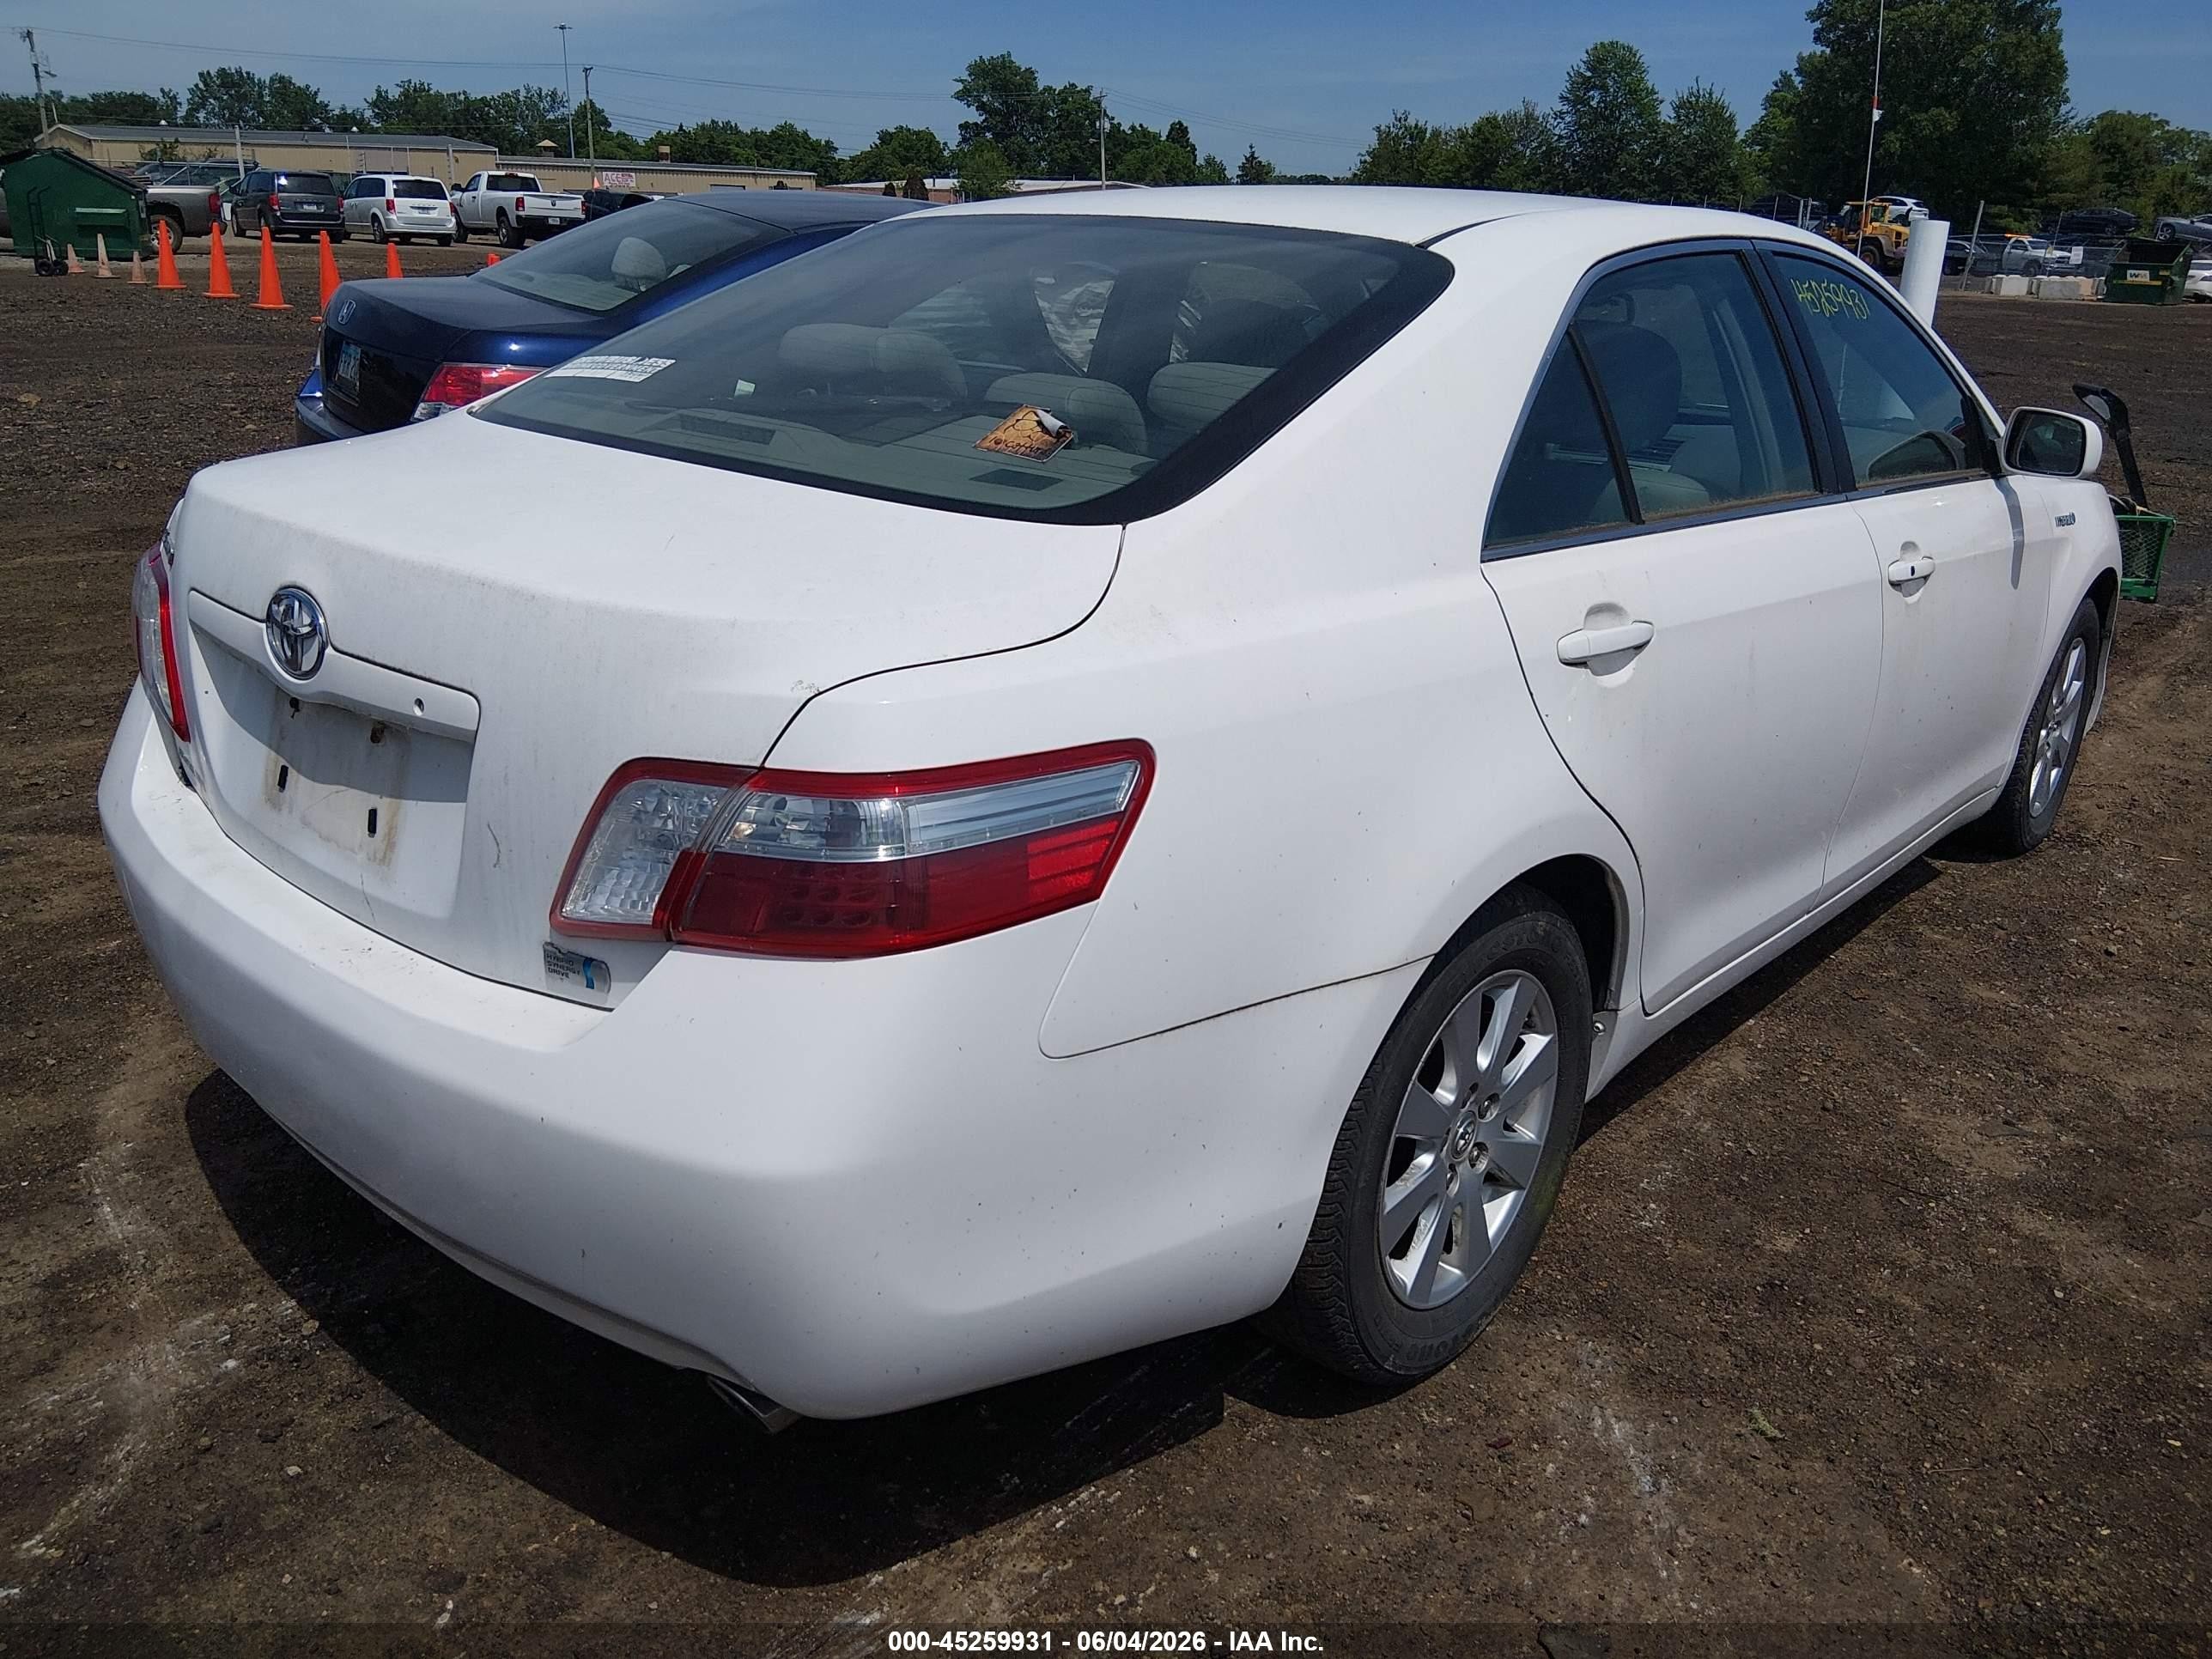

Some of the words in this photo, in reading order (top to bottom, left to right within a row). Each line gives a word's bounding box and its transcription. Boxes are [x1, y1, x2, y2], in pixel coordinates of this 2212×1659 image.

[1790, 278, 1870, 319] 45259931
[547, 960, 580, 975] SYNERGY
[548, 967, 570, 979] DRIVE
